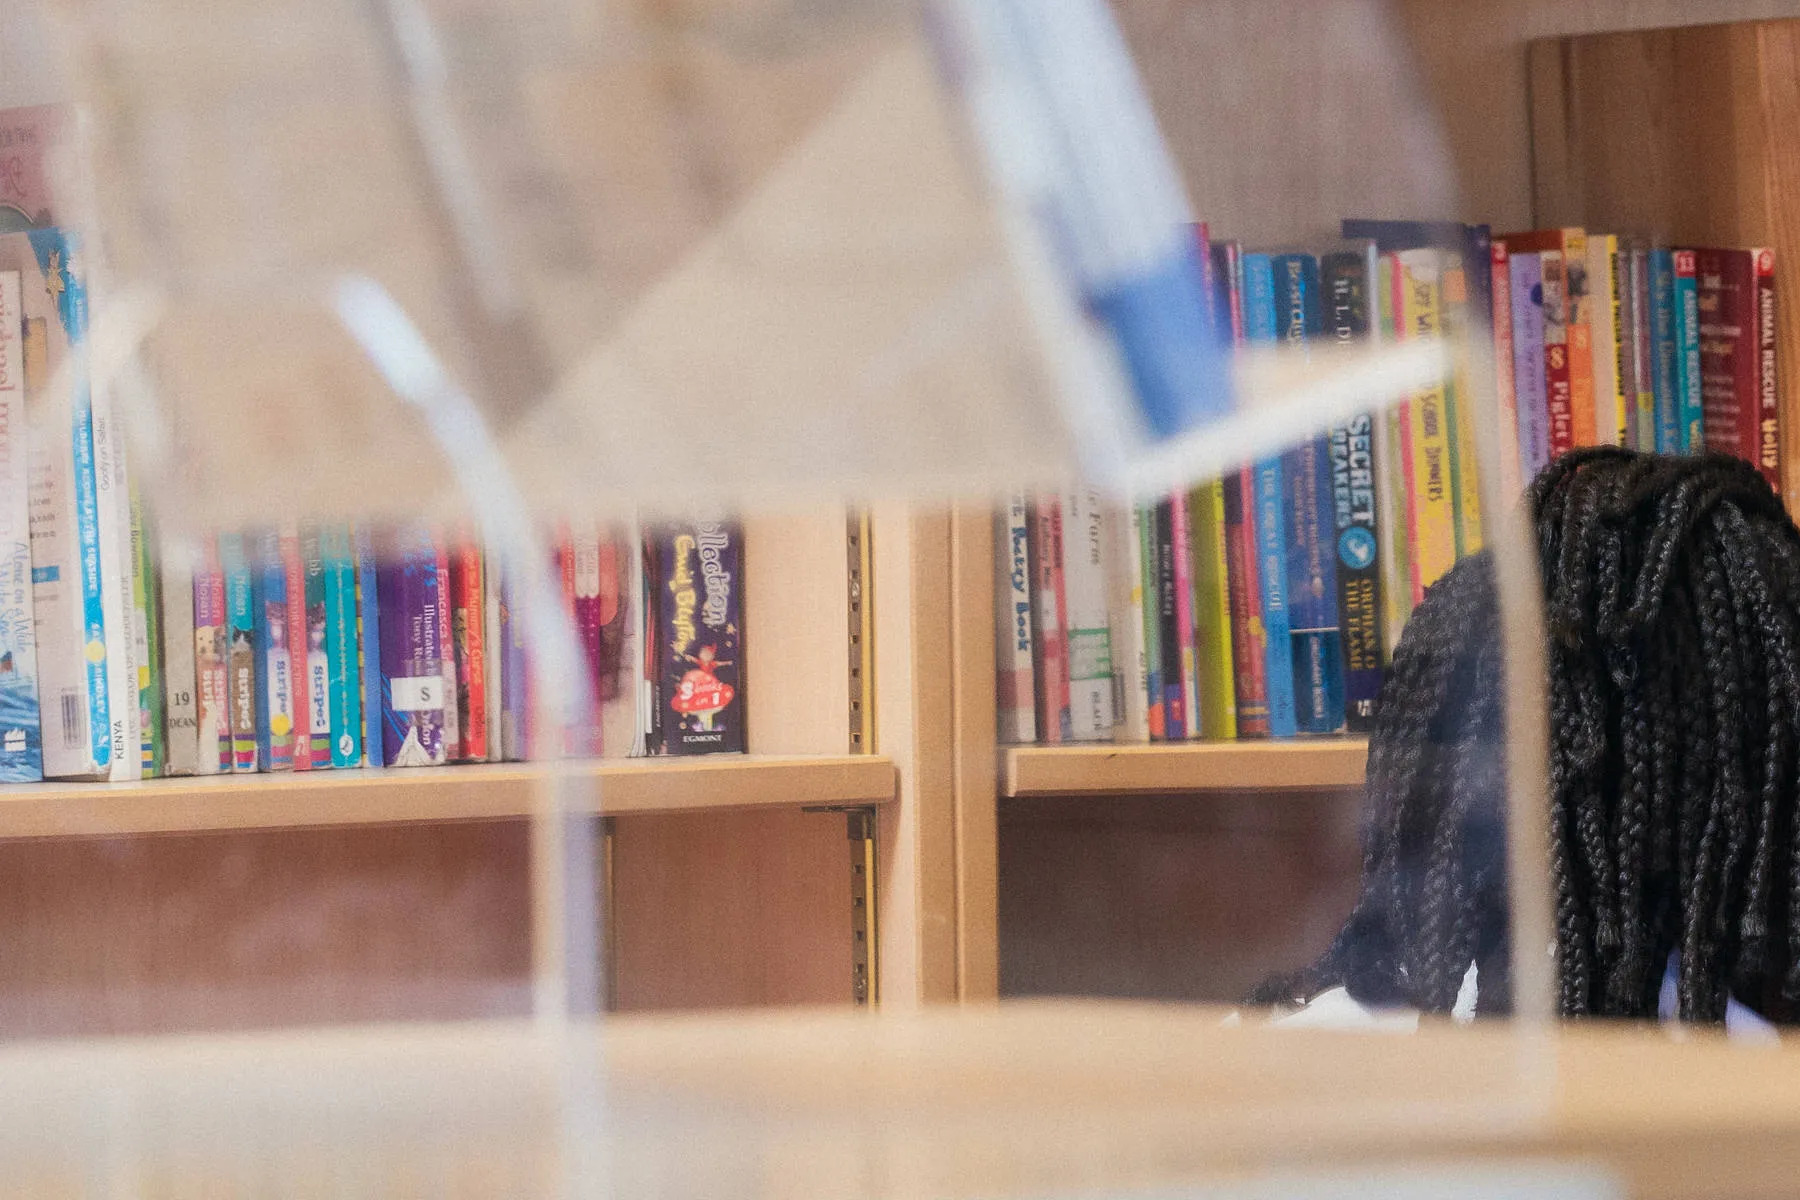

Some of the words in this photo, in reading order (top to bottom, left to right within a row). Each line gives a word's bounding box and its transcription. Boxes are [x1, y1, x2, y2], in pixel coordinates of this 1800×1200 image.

[1761, 288, 1775, 345] ANIMAL
[1762, 350, 1776, 408] RESCUE
[1552, 380, 1570, 440] Piglet
[1348, 414, 1376, 526] SECRET
[14, 542, 30, 585] Alone
[696, 520, 732, 628] ollection
[1011, 527, 1029, 593] Poetry
[411, 614, 423, 644] Tony
[436, 568, 450, 639] Francesca
[1016, 602, 1031, 651] Book
[423, 604, 436, 665] Illustrated
[174, 691, 190, 706] 19
[276, 660, 290, 713] Stripe
[420, 686, 431, 702] S
[113, 719, 125, 760] KENYA
[682, 734, 722, 743] EGMONT
